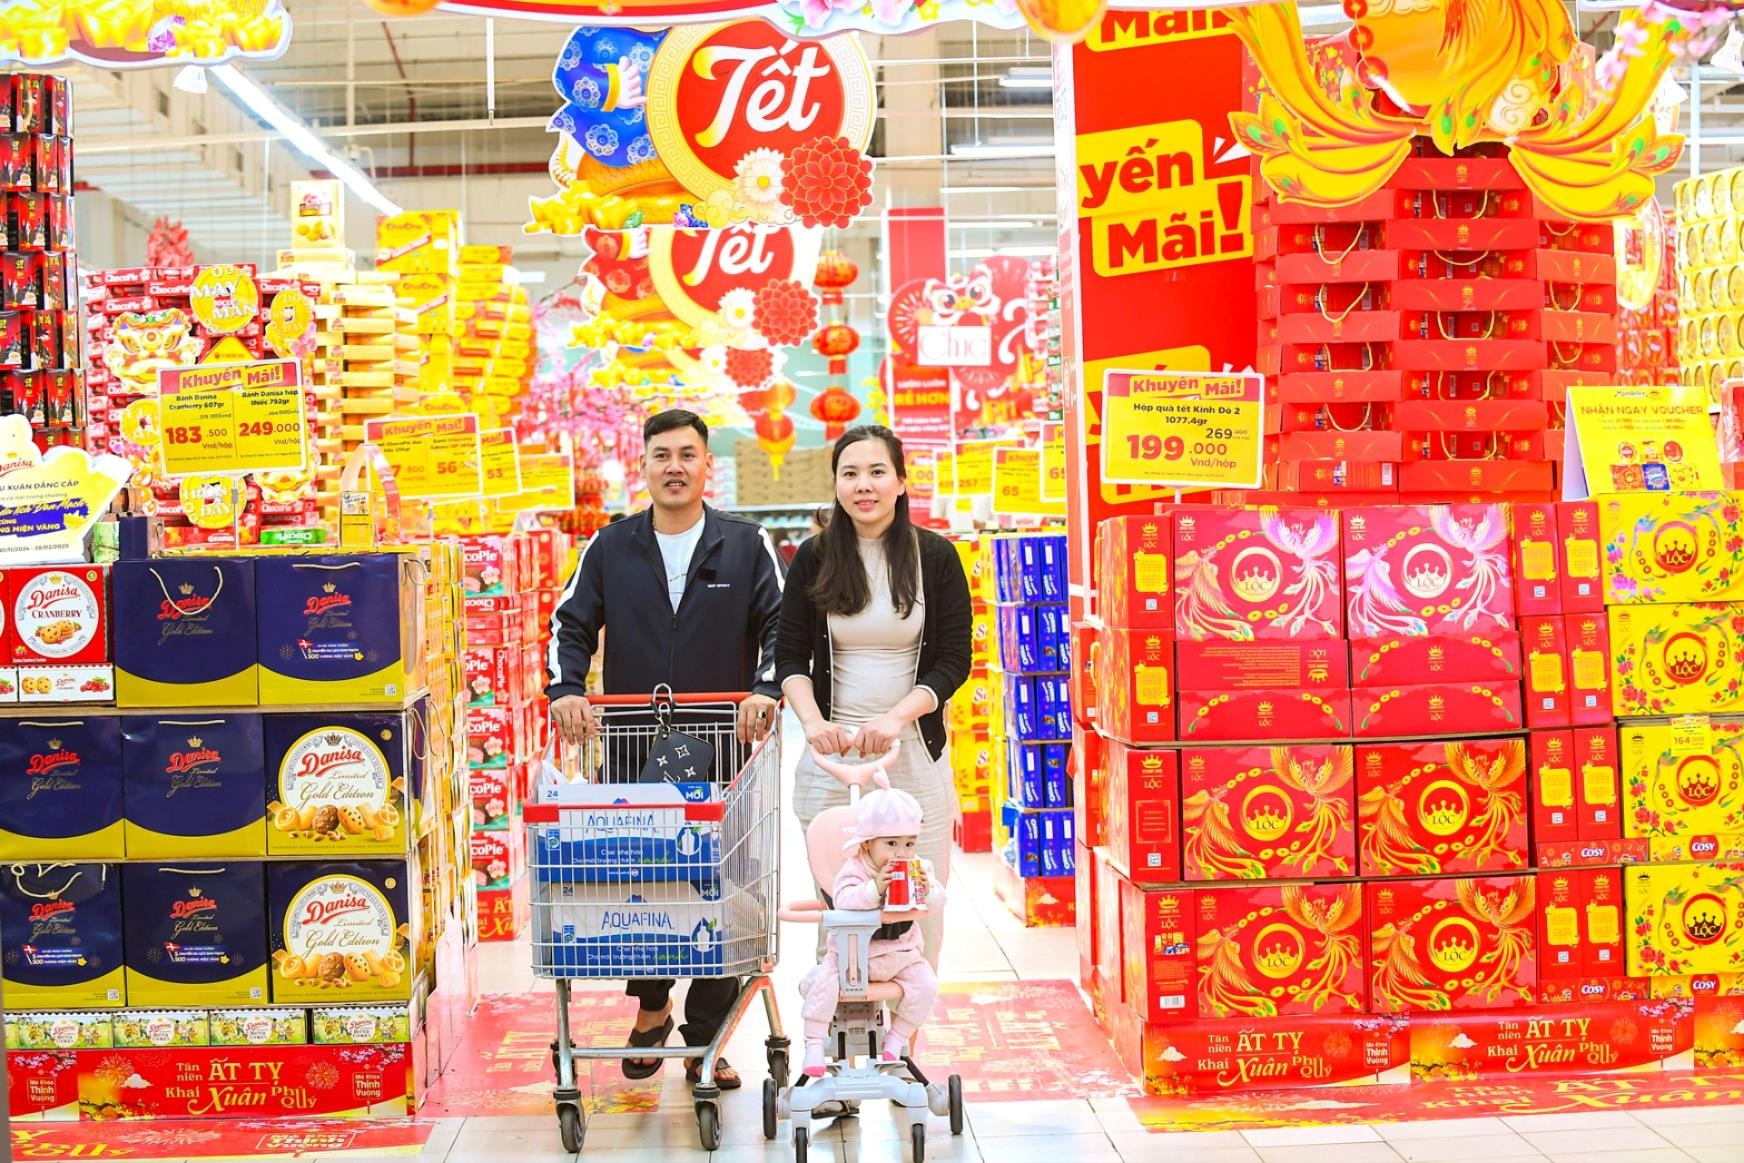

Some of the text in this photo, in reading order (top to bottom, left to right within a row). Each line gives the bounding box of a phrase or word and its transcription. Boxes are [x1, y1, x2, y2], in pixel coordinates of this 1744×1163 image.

[692, 38, 831, 148] Tết
[1079, 138, 1194, 209] yến
[1108, 181, 1244, 268] Mãi!
[182, 365, 280, 388] Khuyến Mãi!
[1133, 375, 1242, 396] Khuyến Mãi!
[169, 401, 225, 410] Cranberry 607gr
[194, 393, 217, 401] Danisa
[269, 398, 290, 407] 792gr
[1133, 403, 1154, 413] Hộp
[1156, 403, 1175, 413] quà
[1193, 404, 1215, 414] Kinh
[1234, 406, 1241, 415] 2
[1581, 403, 1704, 417] NHẬN NGAY VOUCHER
[239, 421, 301, 437] 249 .000
[1165, 416, 1208, 426] 1077.4gr
[165, 426, 228, 445] 183 .500
[1205, 428, 1233, 440] 269
[1126, 434, 1227, 461] 199 .000
[437, 461, 457, 475] 56
[1191, 457, 1237, 469] Vnd/hộp
[36, 522, 61, 532] VÀNG
[465, 551, 497, 562] coPie
[1664, 551, 1688, 568] LỘC
[27, 583, 81, 610] Danisa
[304, 592, 352, 615] Danisa
[31, 609, 83, 620] CRANBERRY
[1674, 658, 1697, 678] LỘC
[468, 721, 500, 733] coPie
[26, 748, 80, 775] Danisa
[165, 746, 222, 773] Danisa
[296, 745, 366, 778] Danisa
[328, 770, 369, 780] Limited
[294, 781, 375, 811] Gold Edition
[470, 783, 502, 794] coPie
[547, 789, 558, 798] 24
[1687, 782, 1711, 801] LỘC
[586, 813, 658, 834] AQUAFINA
[1255, 814, 1278, 832] LỘC
[1432, 810, 1455, 826] LỘC
[471, 844, 503, 856] coPie
[1581, 847, 1605, 858] COSY
[1691, 842, 1716, 853] COSY
[563, 886, 574, 895] 24
[28, 898, 76, 922] Danisa
[169, 895, 218, 919] Danisa
[302, 893, 371, 925] Danisa
[335, 917, 375, 927] Limited
[601, 911, 675, 931] AQUAFINA
[1693, 920, 1717, 938] LỘC
[301, 928, 380, 960] Gold Edition
[1267, 952, 1291, 970] LỘC
[1443, 946, 1467, 964] LỘC
[1581, 984, 1605, 995] COSY
[1692, 979, 1717, 990] COSY
[1488, 1044, 1576, 1073] Khai Xuân
[1197, 1056, 1289, 1086] Khai Xuân
[165, 1086, 267, 1115] Khai Xuân
